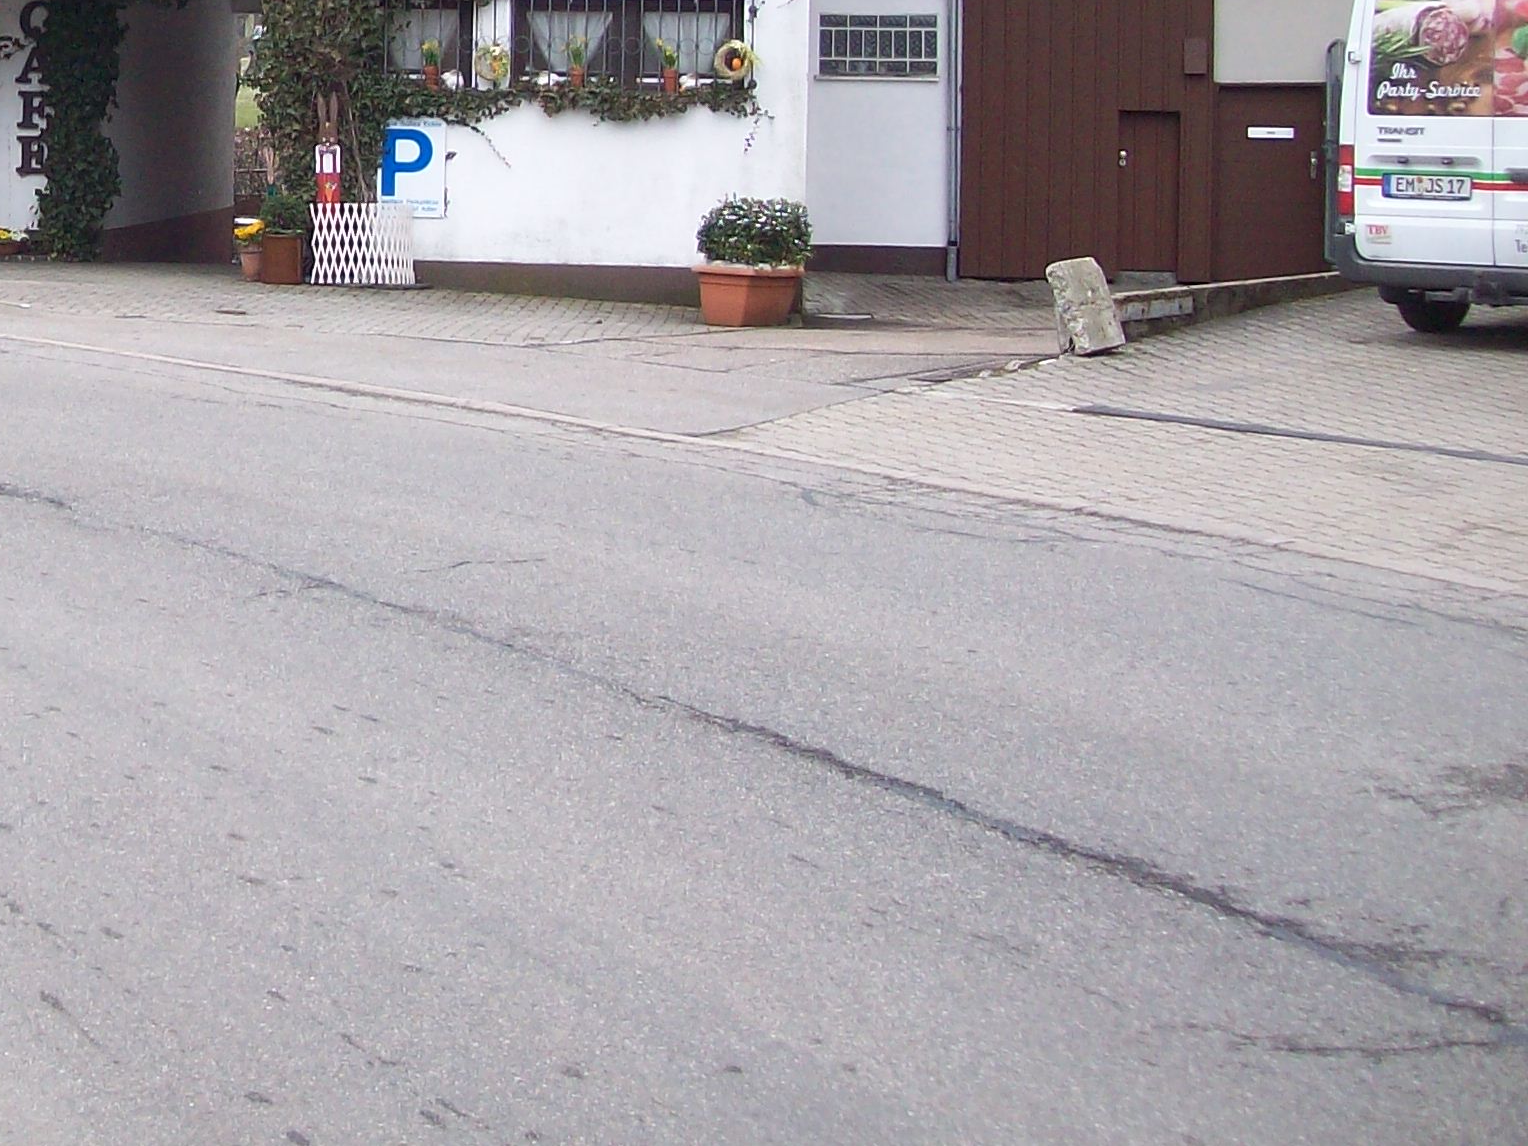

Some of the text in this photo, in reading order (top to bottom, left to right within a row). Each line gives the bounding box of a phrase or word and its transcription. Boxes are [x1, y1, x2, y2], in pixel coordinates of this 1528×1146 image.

[1390, 62, 1417, 79] Ihr
[1376, 81, 1482, 101] Party-Service
[1377, 126, 1425, 135] TRANSIT
[381, 128, 433, 197] P
[1395, 177, 1465, 194] EM JS 17
